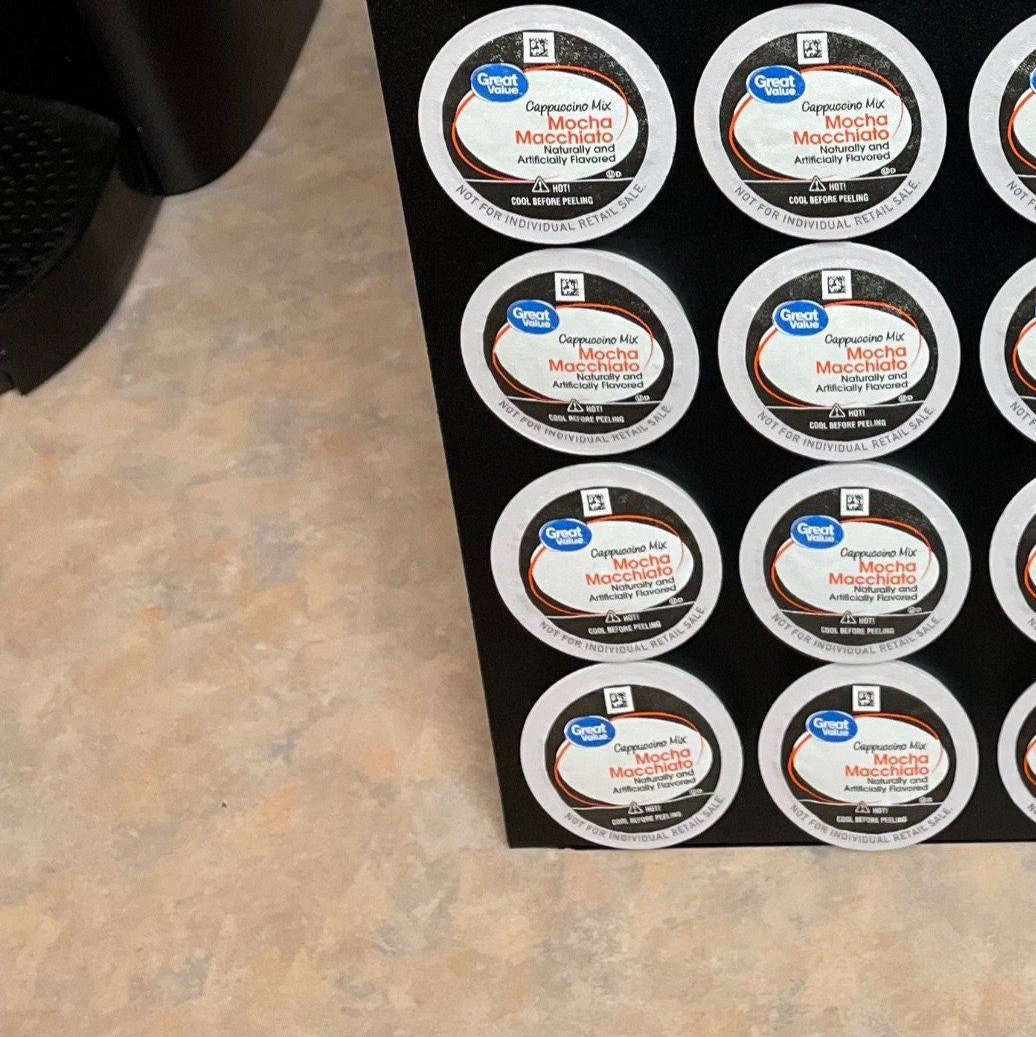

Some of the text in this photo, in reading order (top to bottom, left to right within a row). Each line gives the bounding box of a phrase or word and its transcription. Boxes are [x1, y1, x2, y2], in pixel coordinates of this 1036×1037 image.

[476, 72, 519, 87] Great
[754, 75, 795, 89] Great
[486, 86, 519, 94] Value
[764, 87, 796, 96] Value
[526, 100, 611, 116] Cappuccino Mix
[548, 115, 612, 130] Mocha
[825, 113, 888, 129] Mocha
[515, 130, 613, 145] Macchiato
[793, 128, 889, 145] Macchiato
[544, 144, 615, 155] Naturally and
[517, 154, 616, 165] Artificially Flavored
[511, 196, 593, 206] COOL BEFORE PEELING
[456, 184, 478, 205] NOT
[479, 203, 502, 220] FOR
[505, 214, 575, 233] INDIVIDUAL
[578, 208, 619, 228] RETAIL
[512, 307, 550, 321] Great
[779, 309, 819, 322] Great
[521, 320, 551, 328] Value
[788, 321, 819, 329] Value
[578, 347, 639, 361] Mocha
[847, 345, 906, 360] Mocha
[549, 359, 640, 373] Macchiato
[816, 359, 907, 374] Macchiato
[545, 526, 583, 540] Great
[797, 523, 834, 536] Great
[554, 537, 584, 545] Value
[805, 534, 834, 542] Value
[612, 555, 670, 570] Mocha
[859, 560, 917, 573] Mocha
[586, 567, 673, 585] Macchiato
[829, 572, 917, 585] Macchiato
[570, 723, 607, 736] Great
[813, 718, 849, 730] Great
[580, 733, 608, 742] Value
[635, 749, 691, 764] Mocha
[874, 753, 929, 765] Mocha
[609, 760, 693, 778] Macchiato
[845, 764, 929, 776] Macchiato
